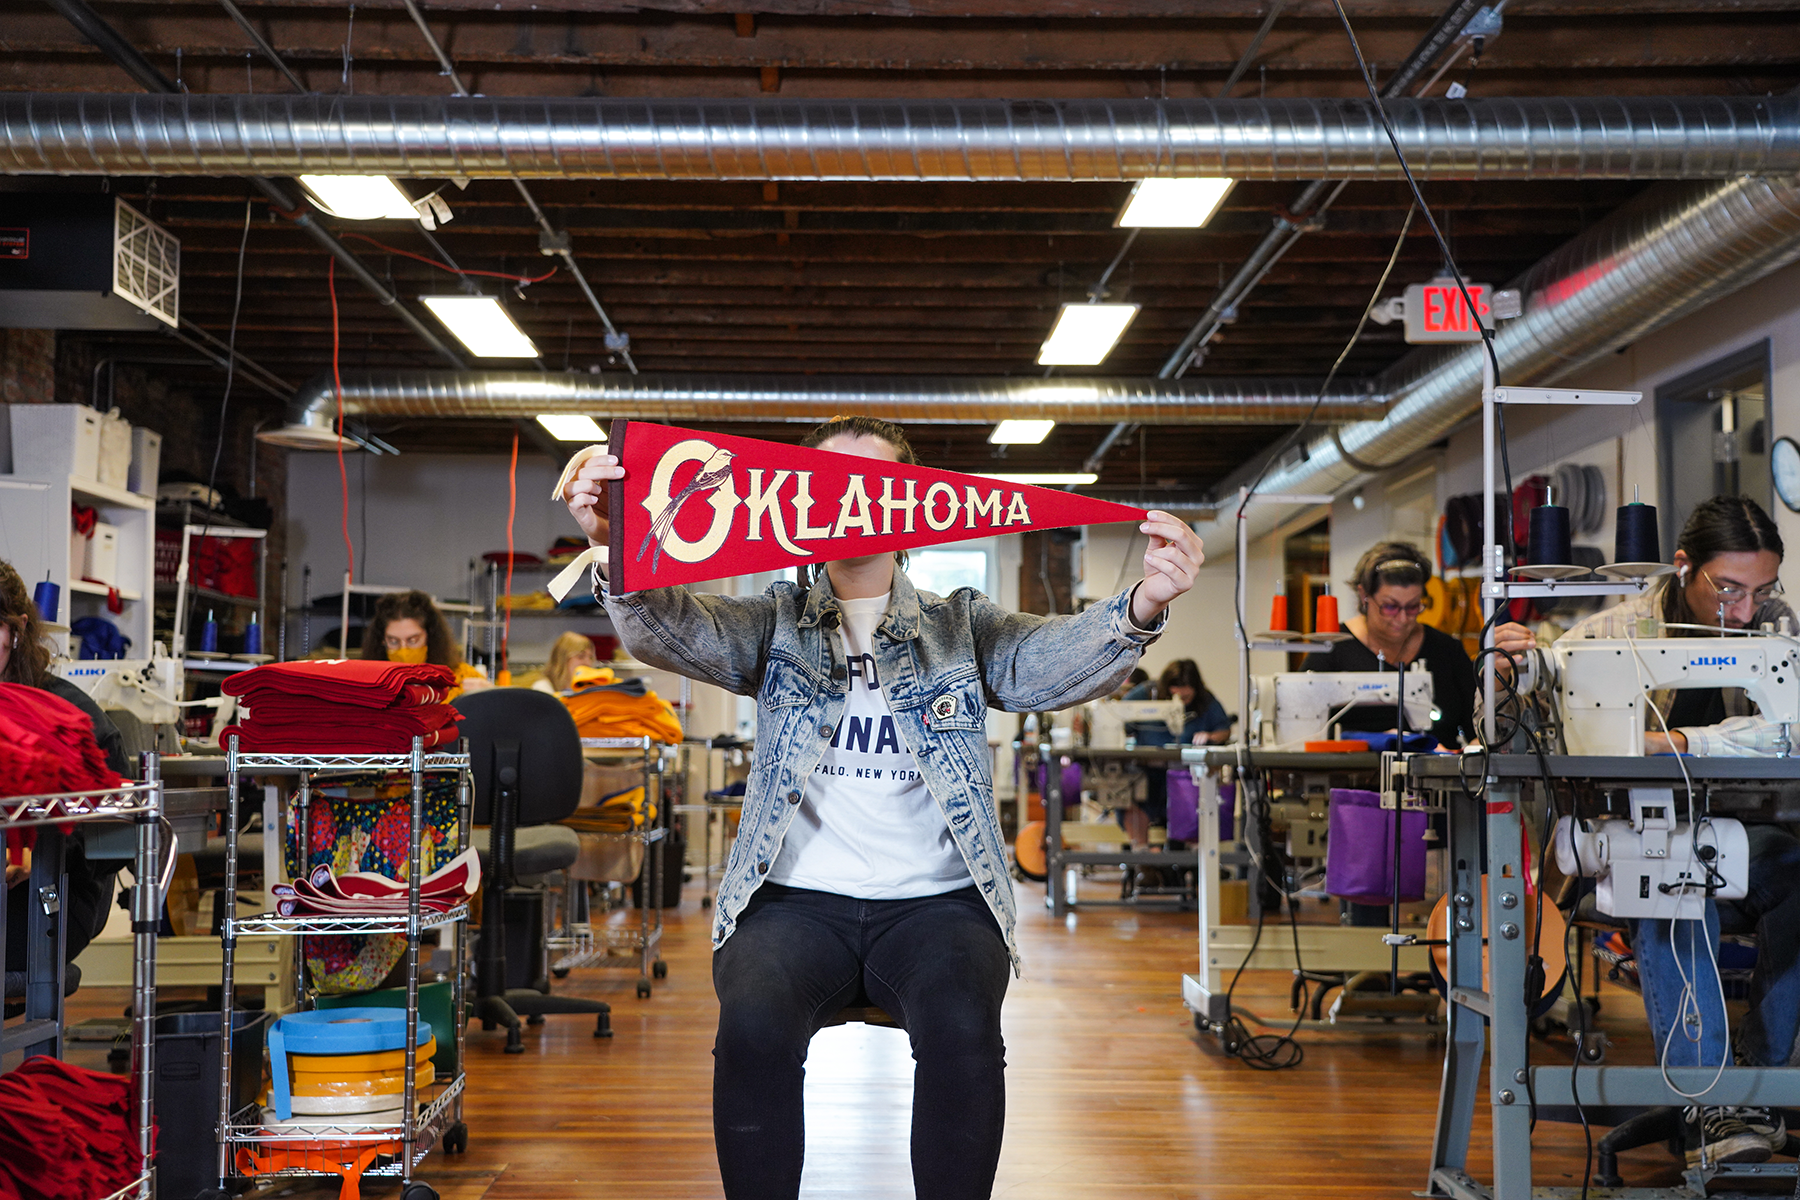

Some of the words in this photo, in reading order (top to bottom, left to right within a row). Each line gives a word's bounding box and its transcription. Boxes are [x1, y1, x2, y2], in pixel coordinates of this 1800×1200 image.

[1423, 286, 1484, 332] EXIT
[641, 439, 1032, 563] OKLAHOMA
[1690, 656, 1737, 666] JUKI
[68, 668, 106, 676] JUKI
[856, 768, 883, 780] NEW
